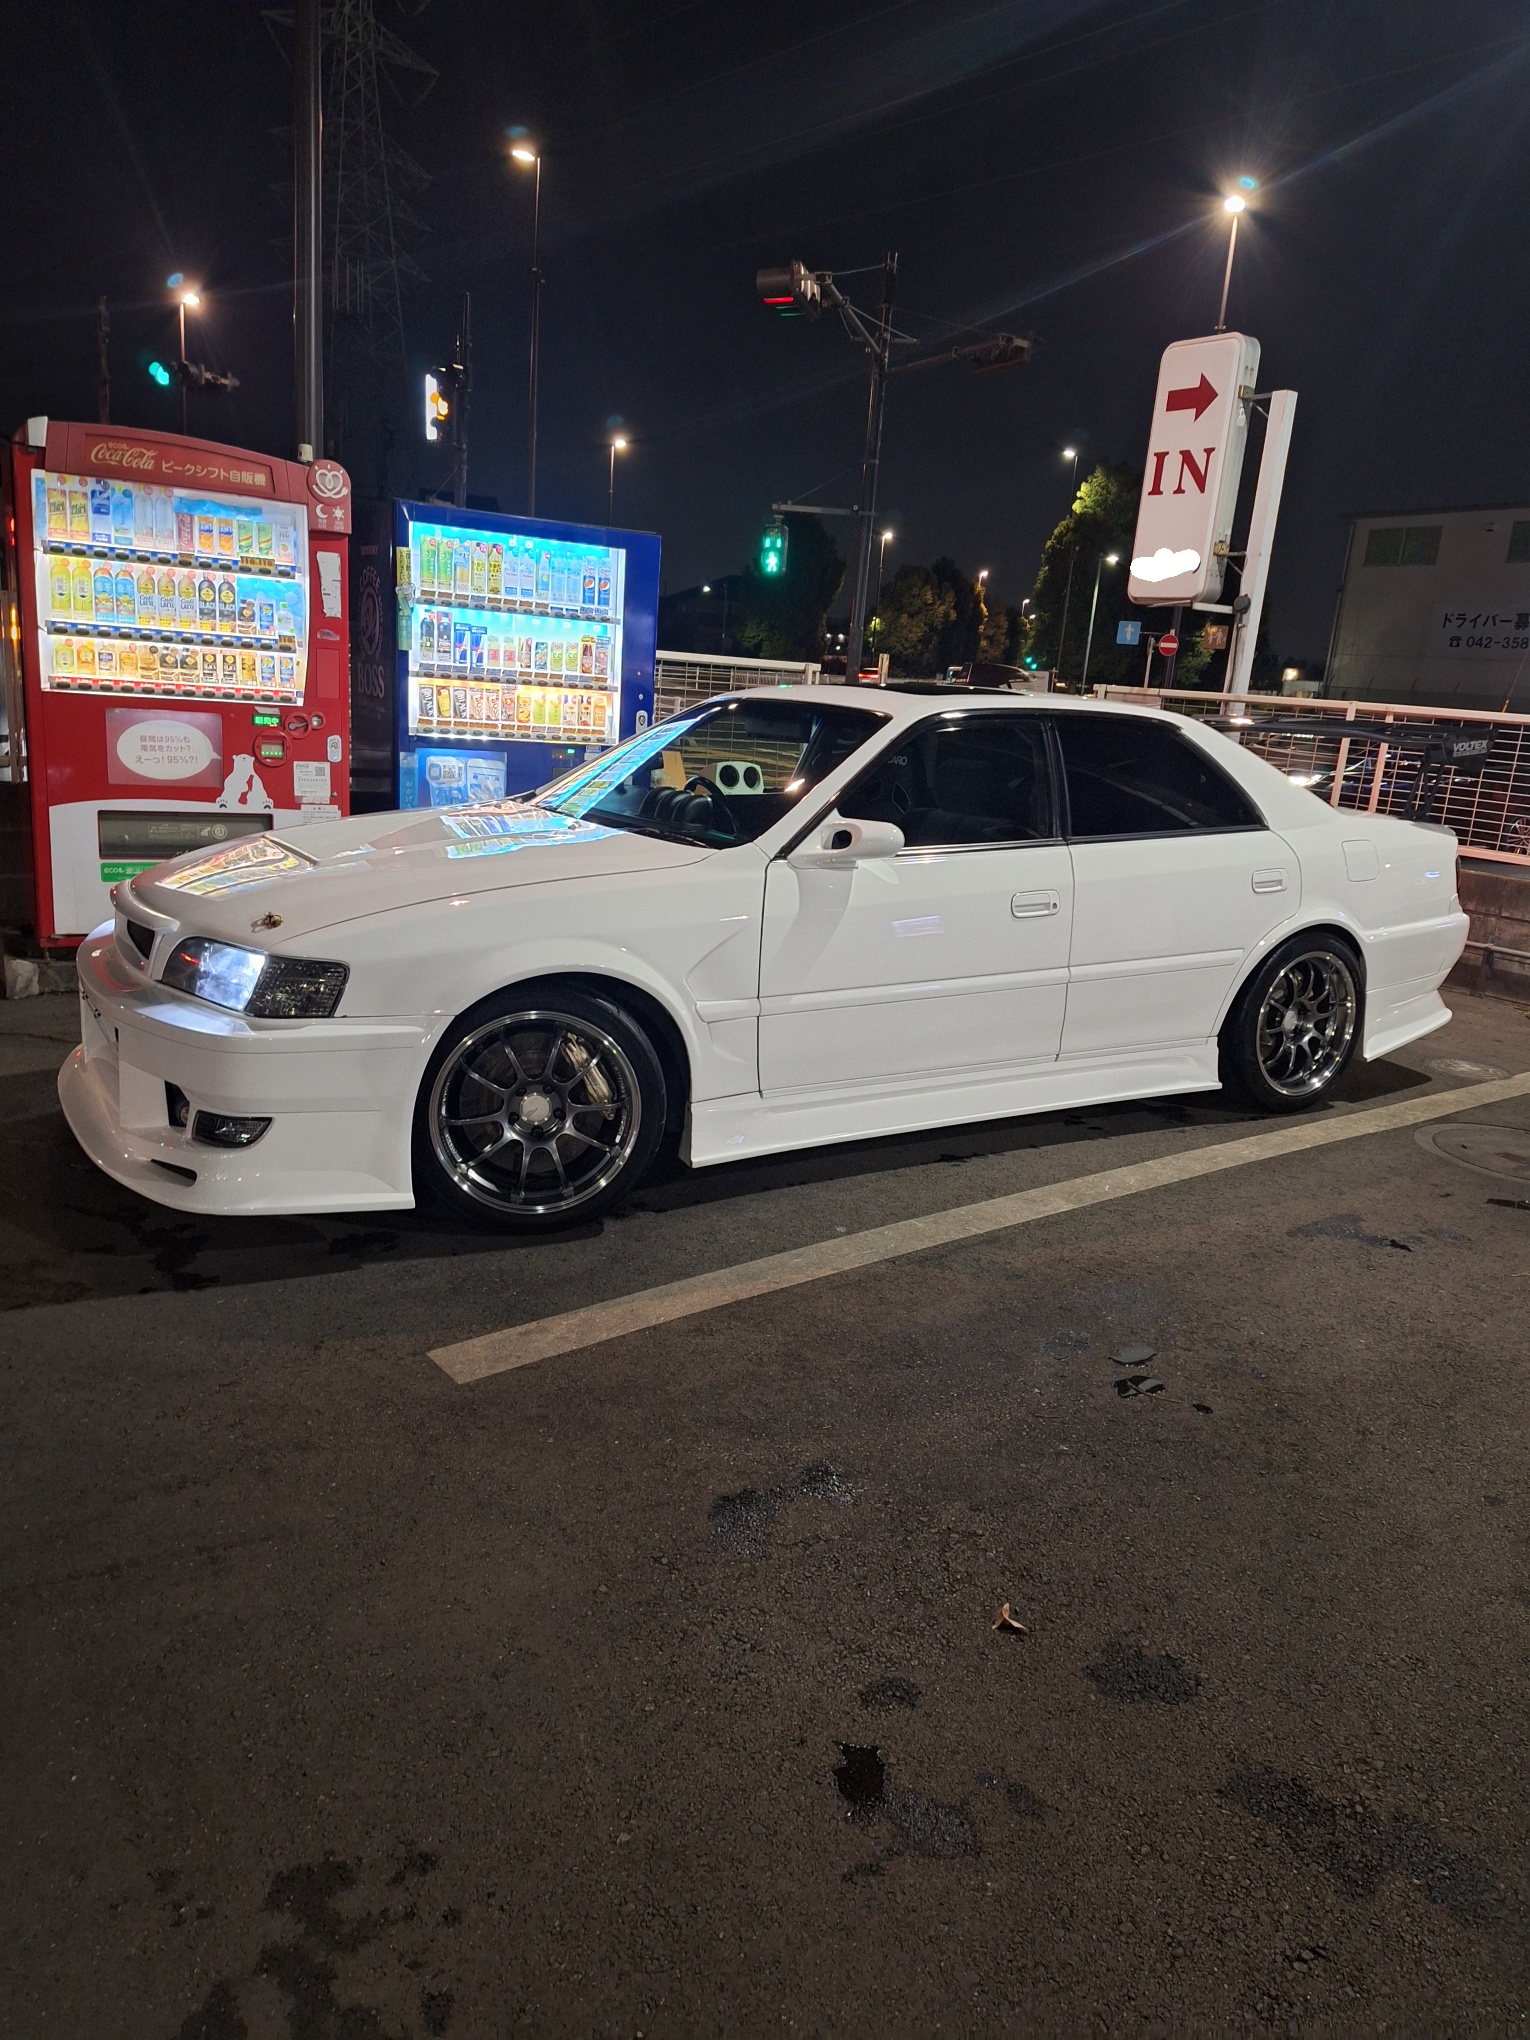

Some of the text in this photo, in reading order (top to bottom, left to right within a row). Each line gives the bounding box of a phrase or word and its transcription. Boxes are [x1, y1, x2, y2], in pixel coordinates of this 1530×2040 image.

[1147, 447, 1216, 496] IN
[356, 662, 385, 698] BOSS
[1453, 740, 1489, 752] VOLTEX
